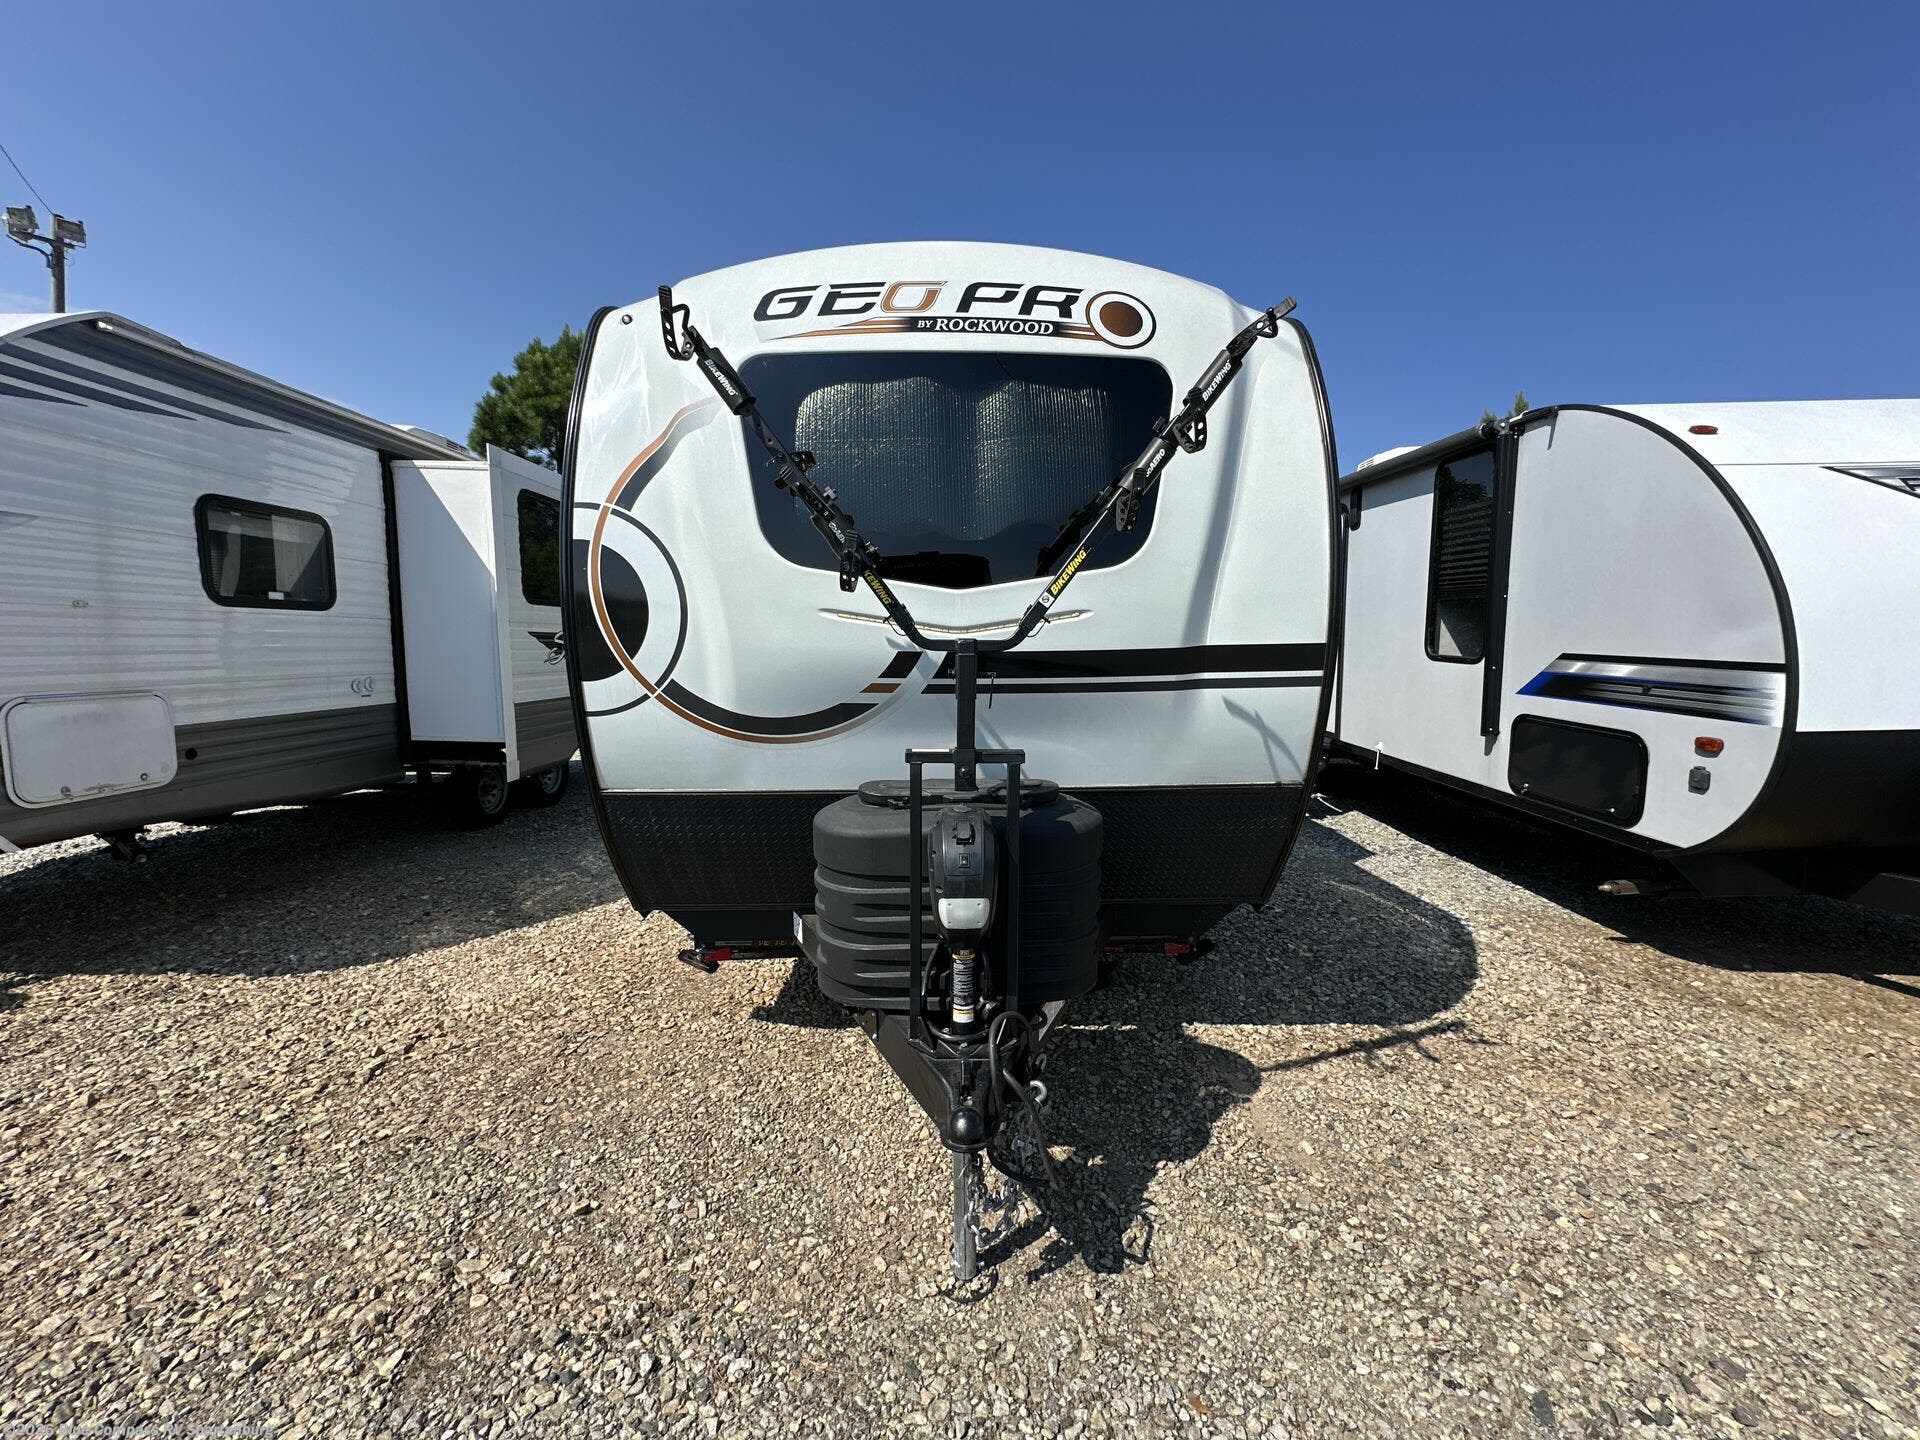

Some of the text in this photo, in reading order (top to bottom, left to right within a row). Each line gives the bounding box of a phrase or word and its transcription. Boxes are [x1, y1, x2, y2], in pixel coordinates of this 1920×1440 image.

[752, 280, 948, 322] GEO
[916, 317, 1055, 336] BY ROCKWOOD
[704, 358, 739, 396] BIKEWING
[1202, 360, 1232, 402] BIKEWING
[863, 569, 892, 605] KEWING
[1050, 548, 1087, 596] BIKEWING
